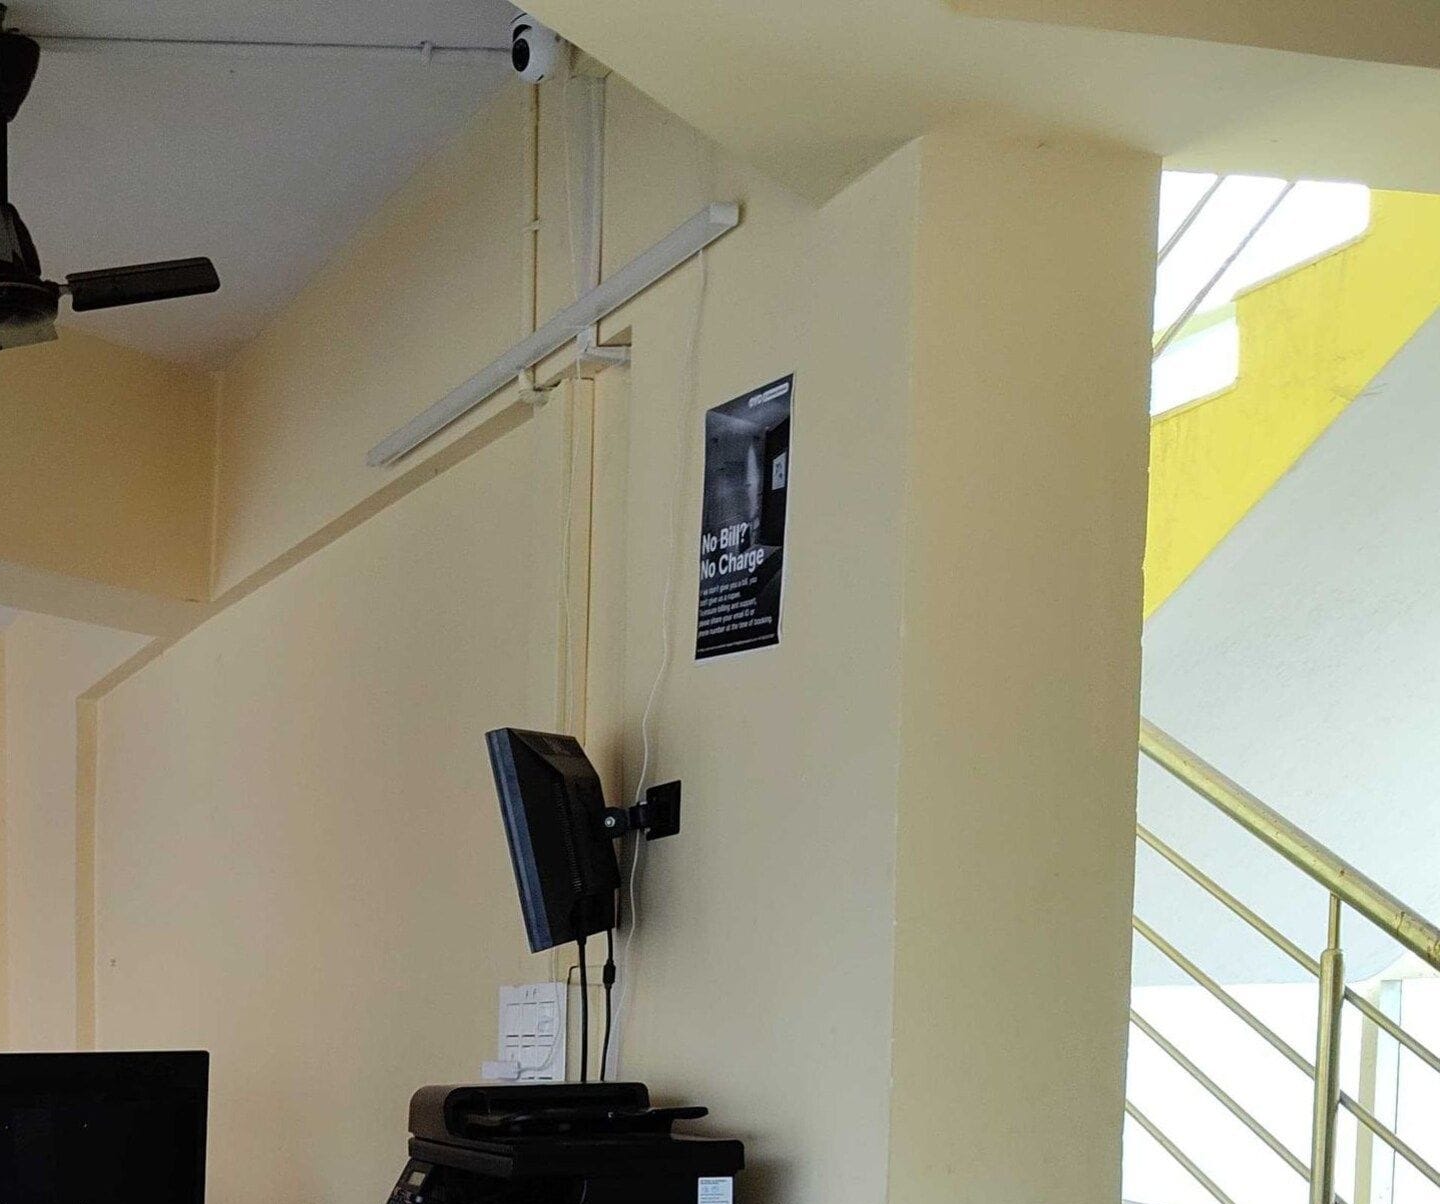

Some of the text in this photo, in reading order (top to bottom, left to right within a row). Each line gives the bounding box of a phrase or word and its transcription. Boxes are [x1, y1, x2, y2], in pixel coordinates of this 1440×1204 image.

[702, 522, 747, 555] No Bill?
[701, 548, 764, 580] No Charge
